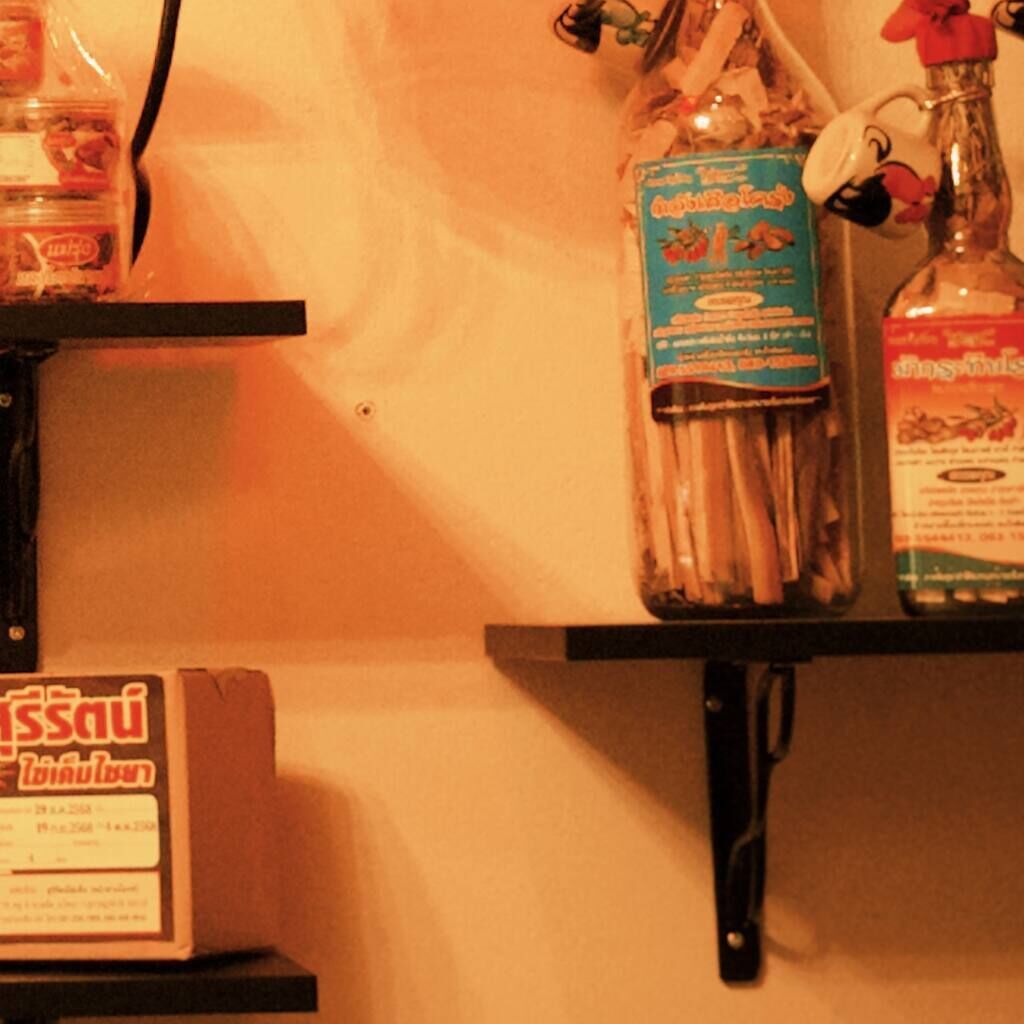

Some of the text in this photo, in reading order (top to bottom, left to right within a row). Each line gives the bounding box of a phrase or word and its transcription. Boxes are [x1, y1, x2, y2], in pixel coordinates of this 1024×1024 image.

[19, 753, 155, 789] ไข่เค็มไชยา
